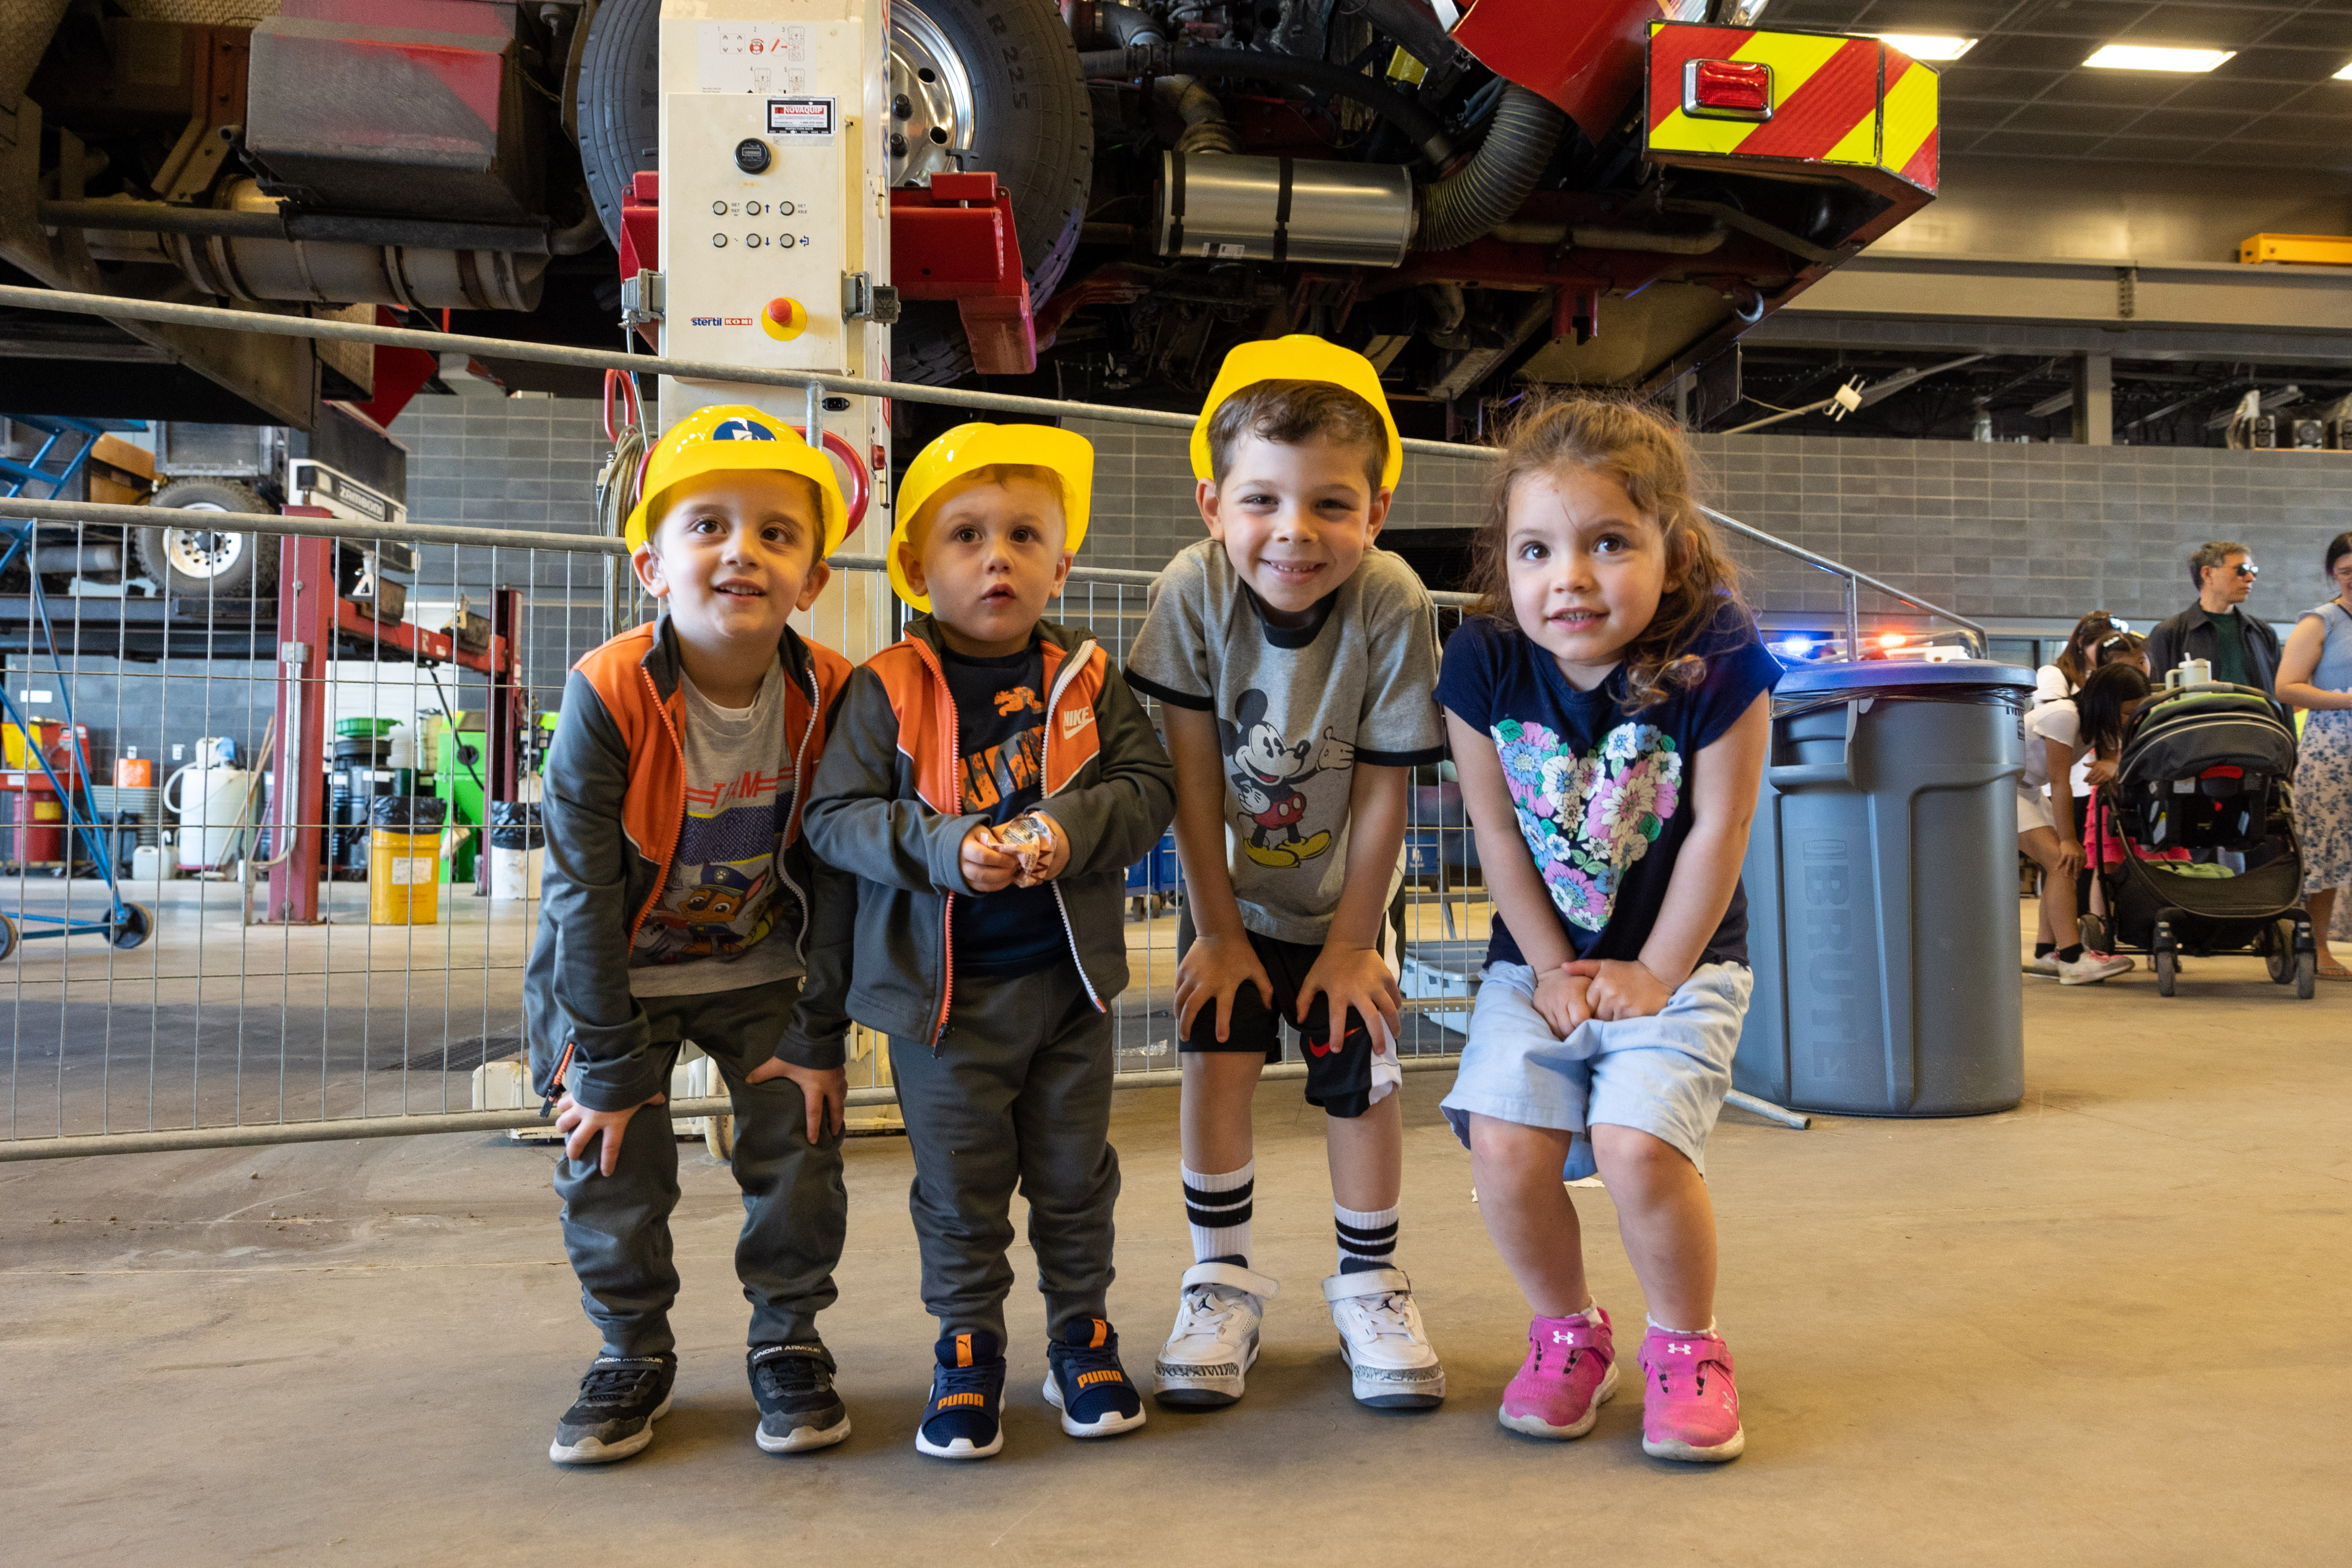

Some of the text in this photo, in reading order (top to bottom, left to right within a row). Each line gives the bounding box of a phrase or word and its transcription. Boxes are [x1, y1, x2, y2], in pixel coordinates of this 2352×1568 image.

[986, 13, 1007, 37] R
[692, 317, 722, 326] stertil
[340, 486, 383, 517] ZAMBONI
[1064, 706, 1090, 727] NIKE
[710, 771, 761, 809] TEAM
[1804, 864, 1854, 1080] BRUTE
[752, 1345, 821, 1360] UNDER ARMOUR
[1077, 1370, 1123, 1388] PUMA
[937, 1393, 984, 1410] PUMA
